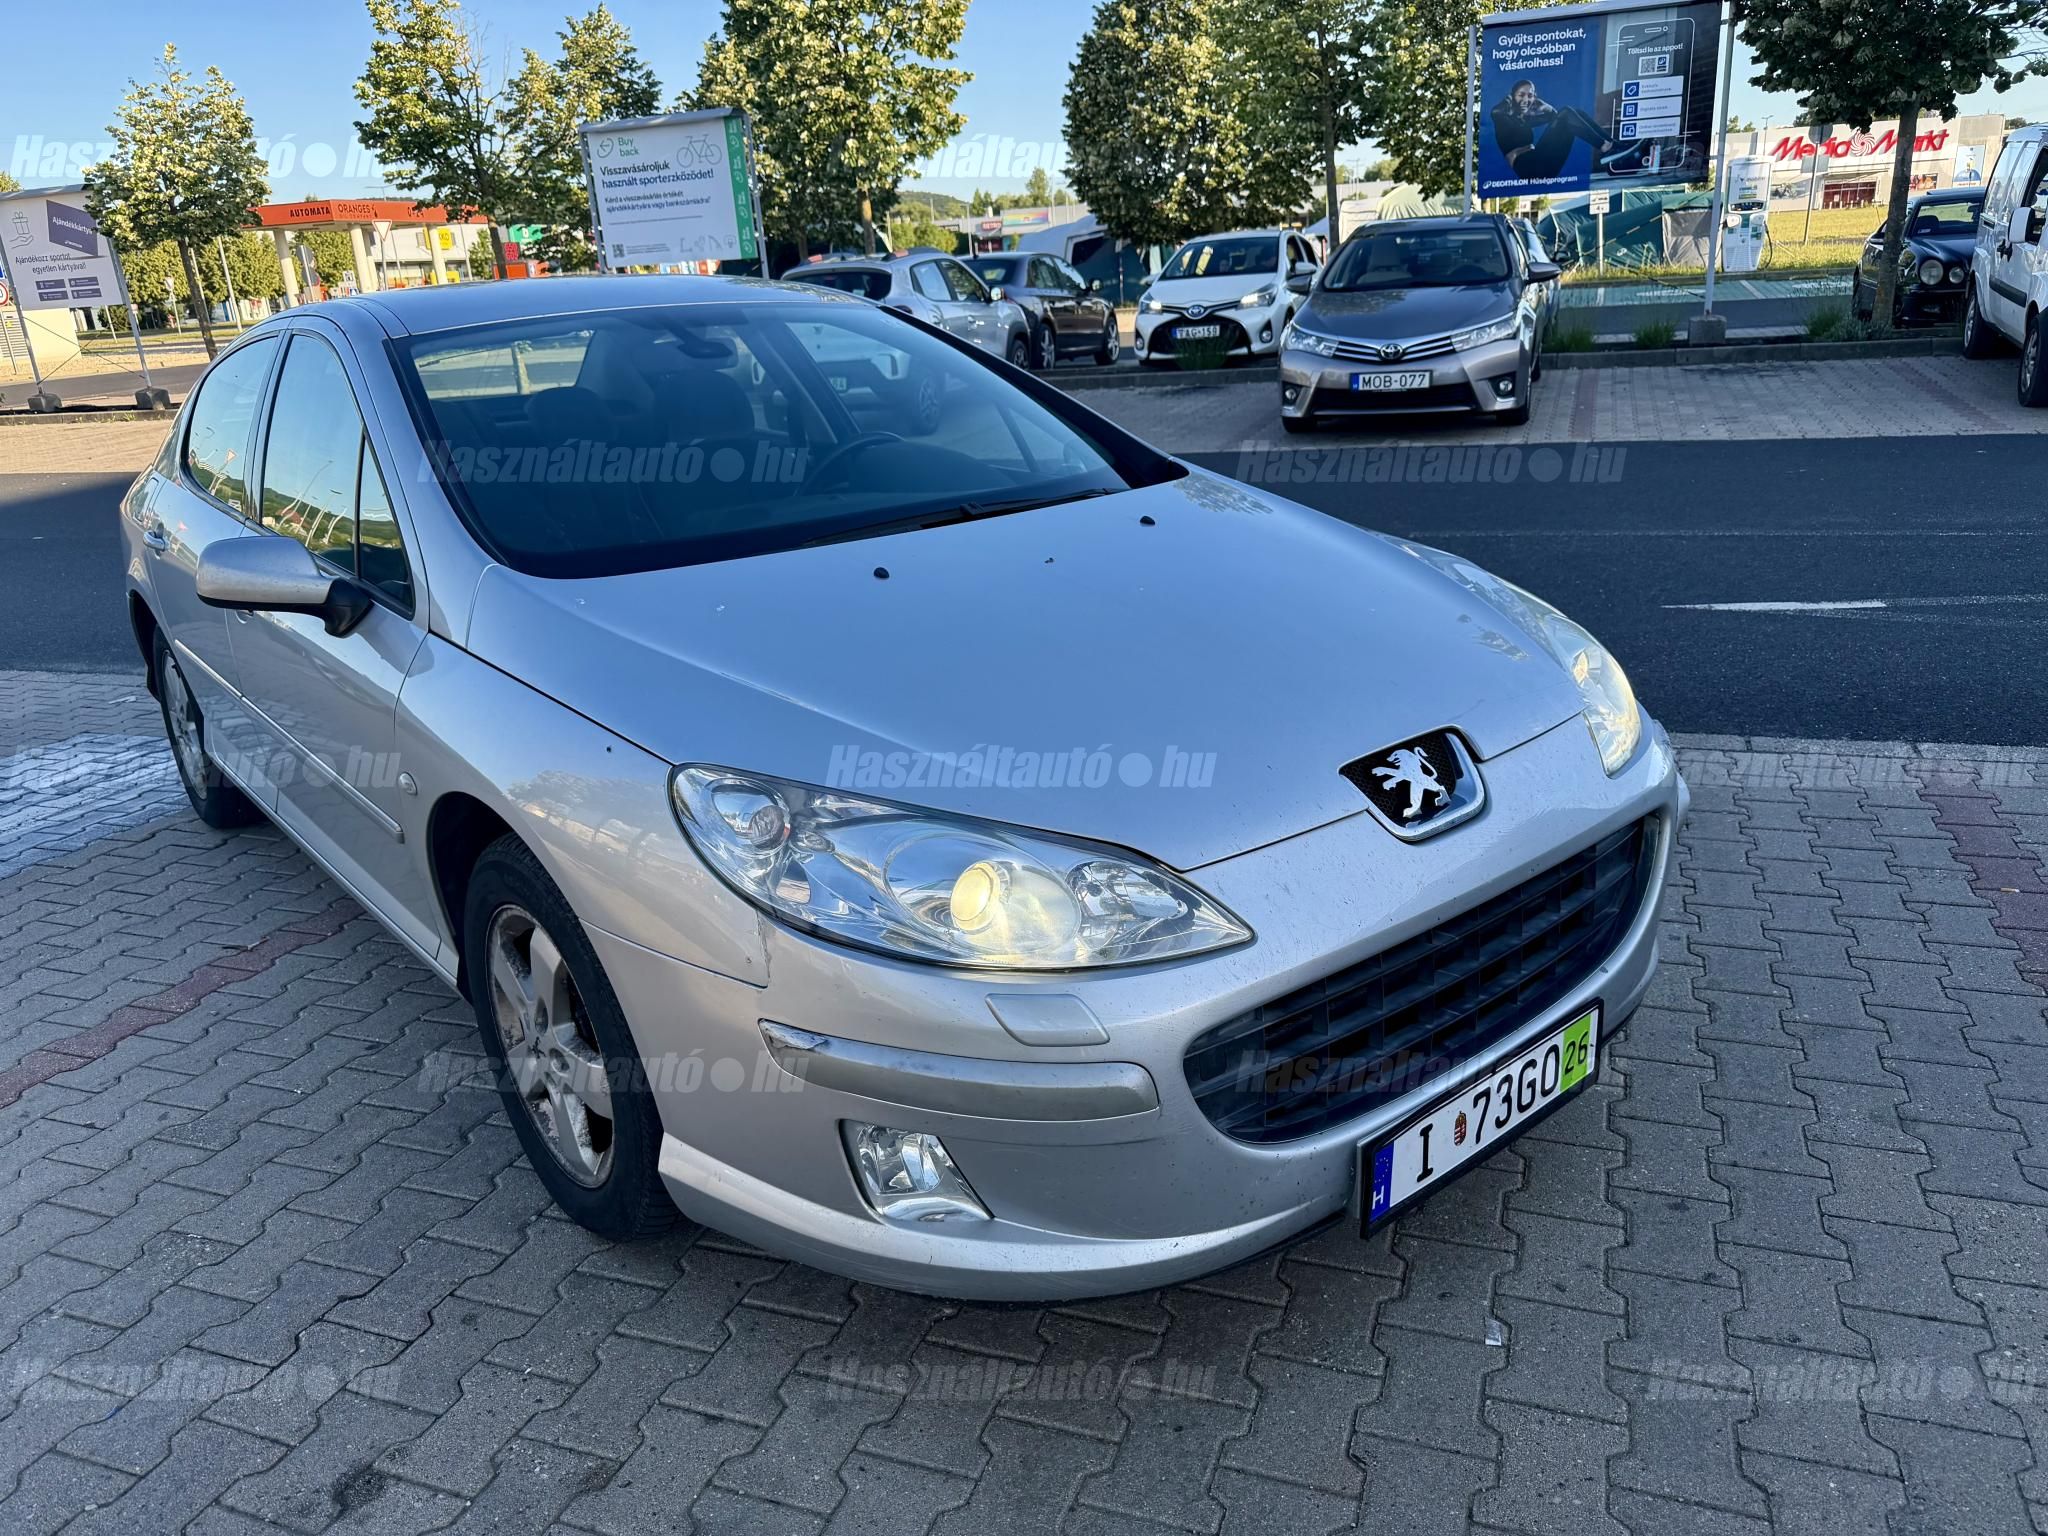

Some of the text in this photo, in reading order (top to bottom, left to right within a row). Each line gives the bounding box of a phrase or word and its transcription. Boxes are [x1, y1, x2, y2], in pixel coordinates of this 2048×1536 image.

[1498, 27, 1587, 46] Gyűjts pontokat,
[1492, 42, 1576, 60] hogy olcsóbban
[1661, 43, 1684, 53] appot!
[1499, 54, 1564, 71] vásárolhass!
[618, 137, 634, 146] Buy
[619, 146, 640, 157] back
[600, 161, 670, 176] Visszavásároljuk
[602, 168, 714, 189] használt sporteszközödet!
[1491, 176, 1578, 188] DECATHLON Hűségprogram
[290, 206, 331, 217] AUTOMATA
[338, 203, 371, 213] ORANGES
[1362, 374, 1426, 389] MOB-077
[1371, 1185, 1385, 1210] H
[1563, 1031, 1589, 1076] 26
